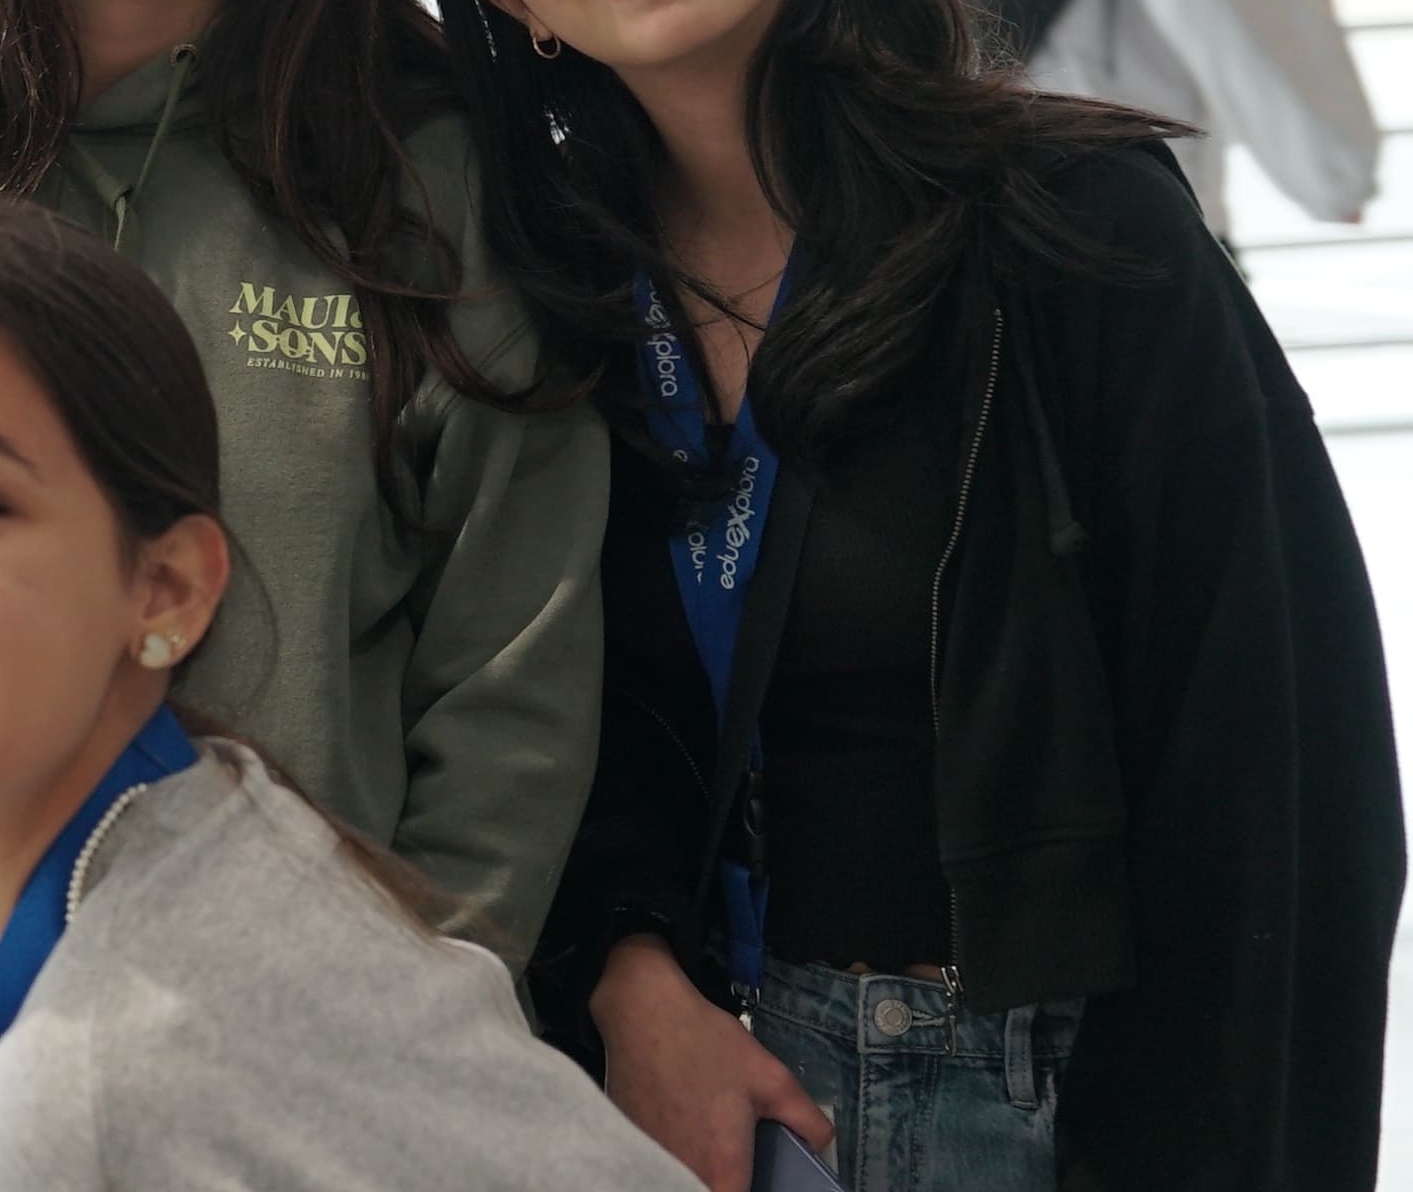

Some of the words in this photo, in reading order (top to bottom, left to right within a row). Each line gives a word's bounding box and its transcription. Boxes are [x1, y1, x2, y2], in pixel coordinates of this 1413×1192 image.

[248, 319, 367, 367] SONS
[246, 357, 326, 379] ESTABLISHED
[329, 369, 344, 379] IN
